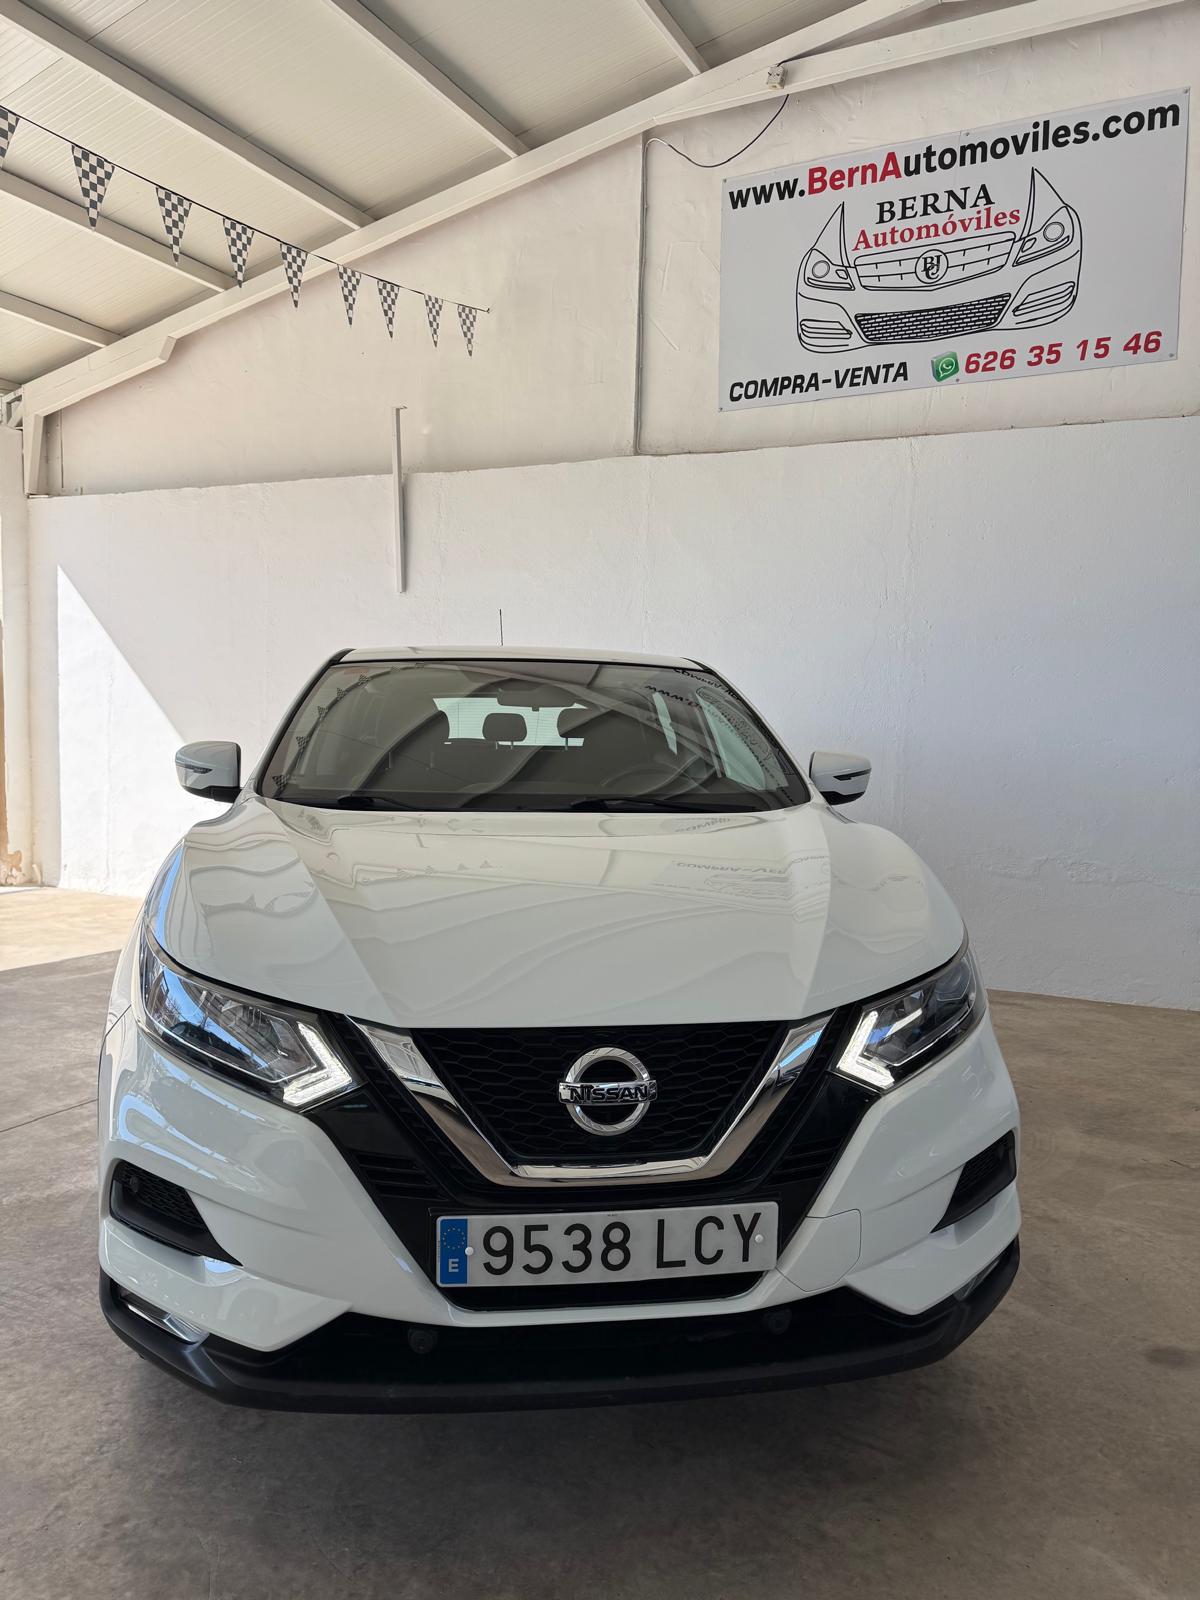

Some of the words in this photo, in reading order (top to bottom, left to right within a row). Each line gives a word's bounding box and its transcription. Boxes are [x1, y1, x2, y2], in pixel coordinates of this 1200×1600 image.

[729, 103, 1180, 210] www.BernAutomoviles.com
[875, 184, 995, 225] BERNA
[852, 207, 1021, 251] Automóviles
[964, 348, 1016, 374] 626
[1027, 343, 1062, 367] 35
[1076, 336, 1110, 361] 15
[1123, 330, 1163, 355] 46
[729, 361, 909, 402] COMPRA-VENTA
[569, 1083, 648, 1103] NISSAN
[482, 1221, 631, 1276] 9538
[656, 1212, 762, 1269] LCY
[448, 1258, 460, 1273] E
